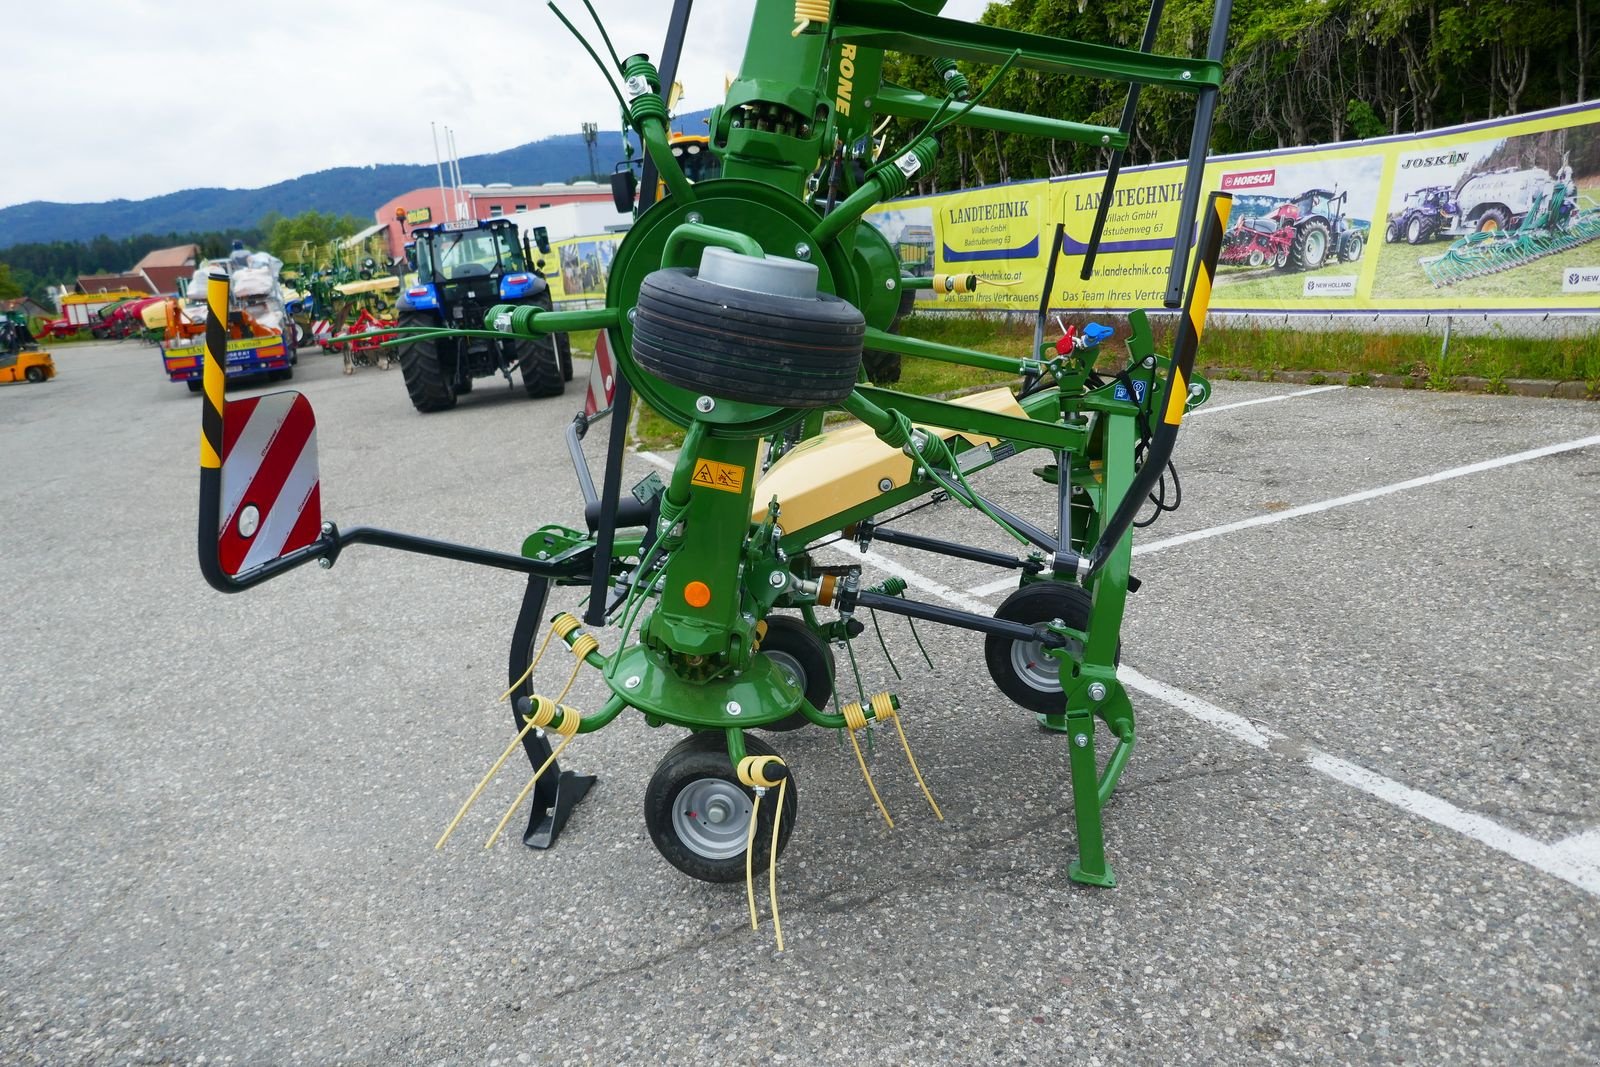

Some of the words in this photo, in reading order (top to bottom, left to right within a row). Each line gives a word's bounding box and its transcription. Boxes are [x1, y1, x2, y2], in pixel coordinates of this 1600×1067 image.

[836, 43, 857, 117] RONE
[1401, 151, 1469, 169] JOSKIN
[1233, 174, 1273, 186] HORSCH
[949, 200, 1029, 224] LANDTECHNIK
[1131, 210, 1158, 220] GmbH
[971, 225, 990, 234] Villach
[990, 224, 1007, 233] GmbH
[1103, 226, 1151, 237] dstubenweg
[1153, 223, 1164, 233] 63
[1004, 235, 1011, 244] 63
[976, 293, 992, 302] Ihres
[993, 293, 1039, 303] Vertrauens
[1062, 291, 1079, 302] Das
[1082, 290, 1104, 301] Team
[1107, 289, 1131, 301] Ihres
